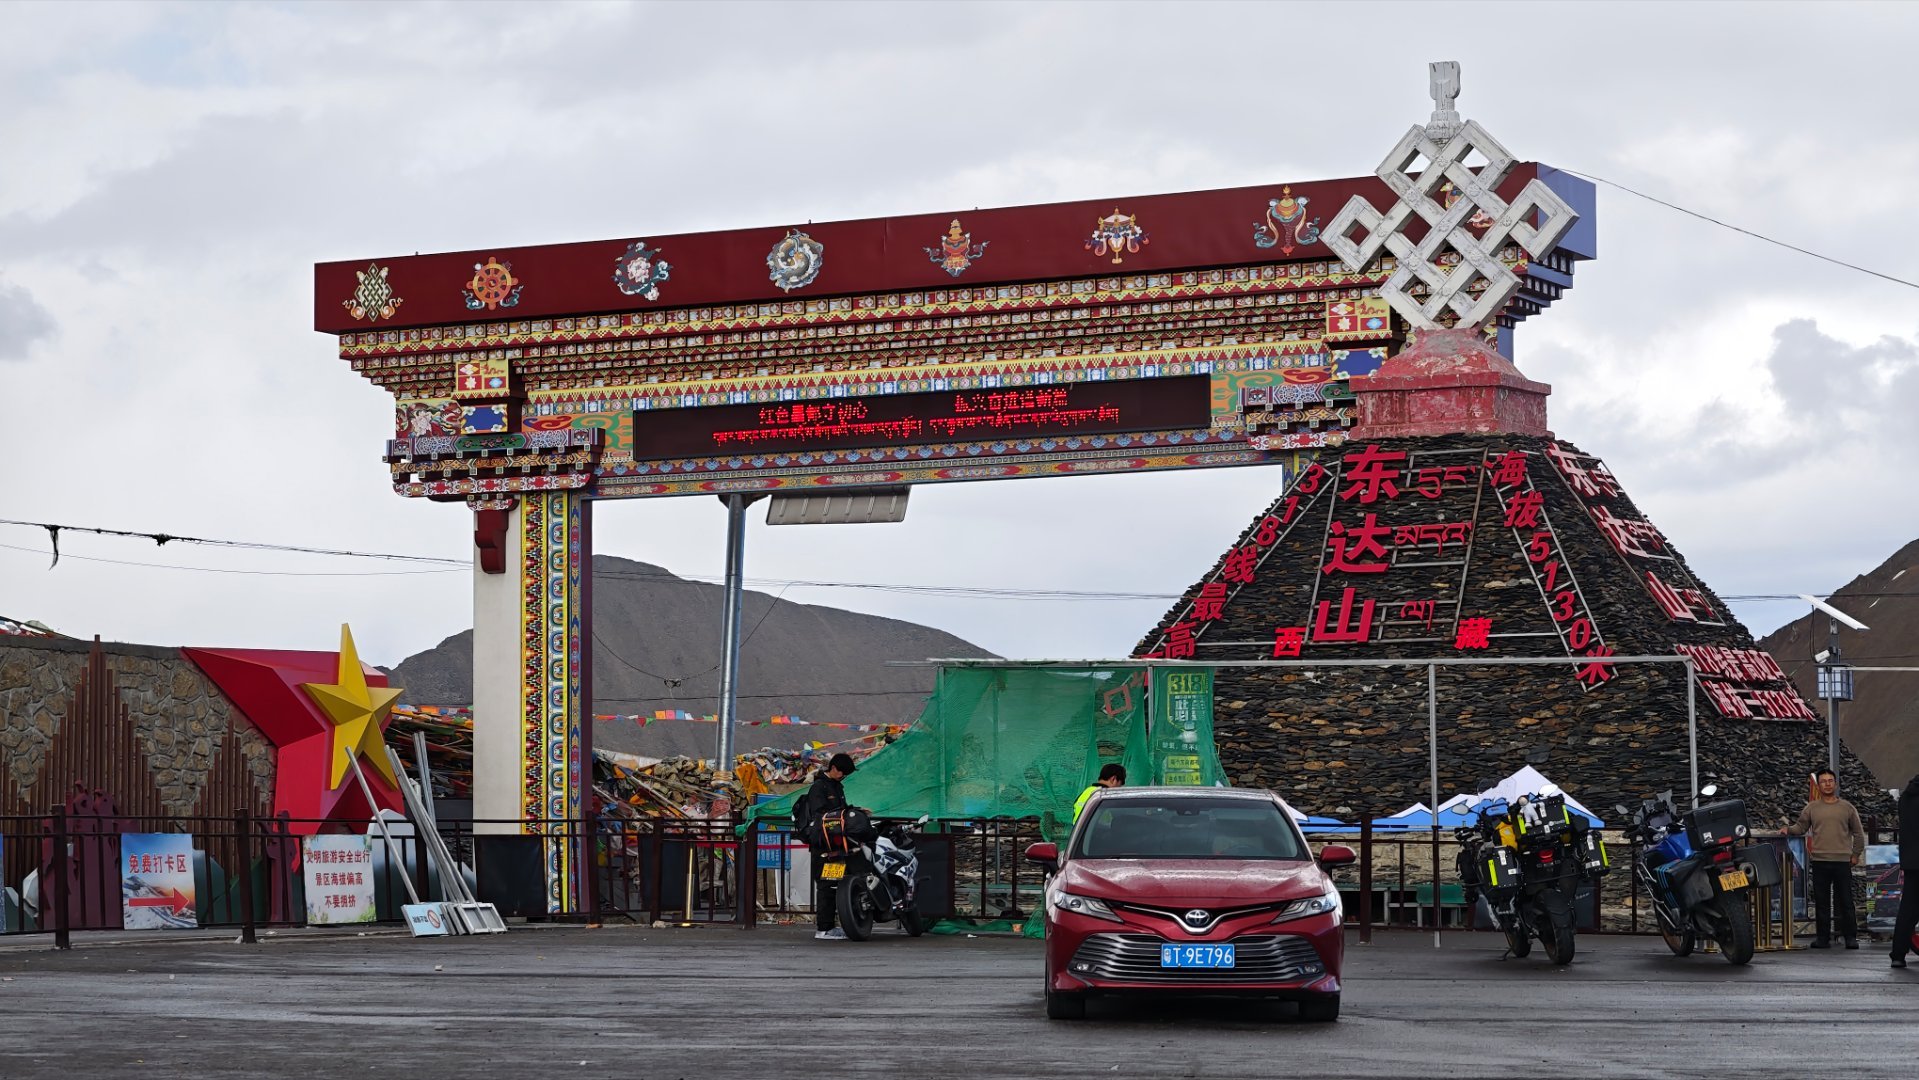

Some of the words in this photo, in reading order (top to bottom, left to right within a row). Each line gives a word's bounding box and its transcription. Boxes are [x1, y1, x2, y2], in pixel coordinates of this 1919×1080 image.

[1312, 445, 1406, 643] 东达山
[129, 853, 186, 874] 免费打卡区
[306, 849, 370, 864] 文明旅游安全出行
[315, 872, 363, 886] 景区海拔偏高
[324, 894, 356, 908] 不要拥挤
